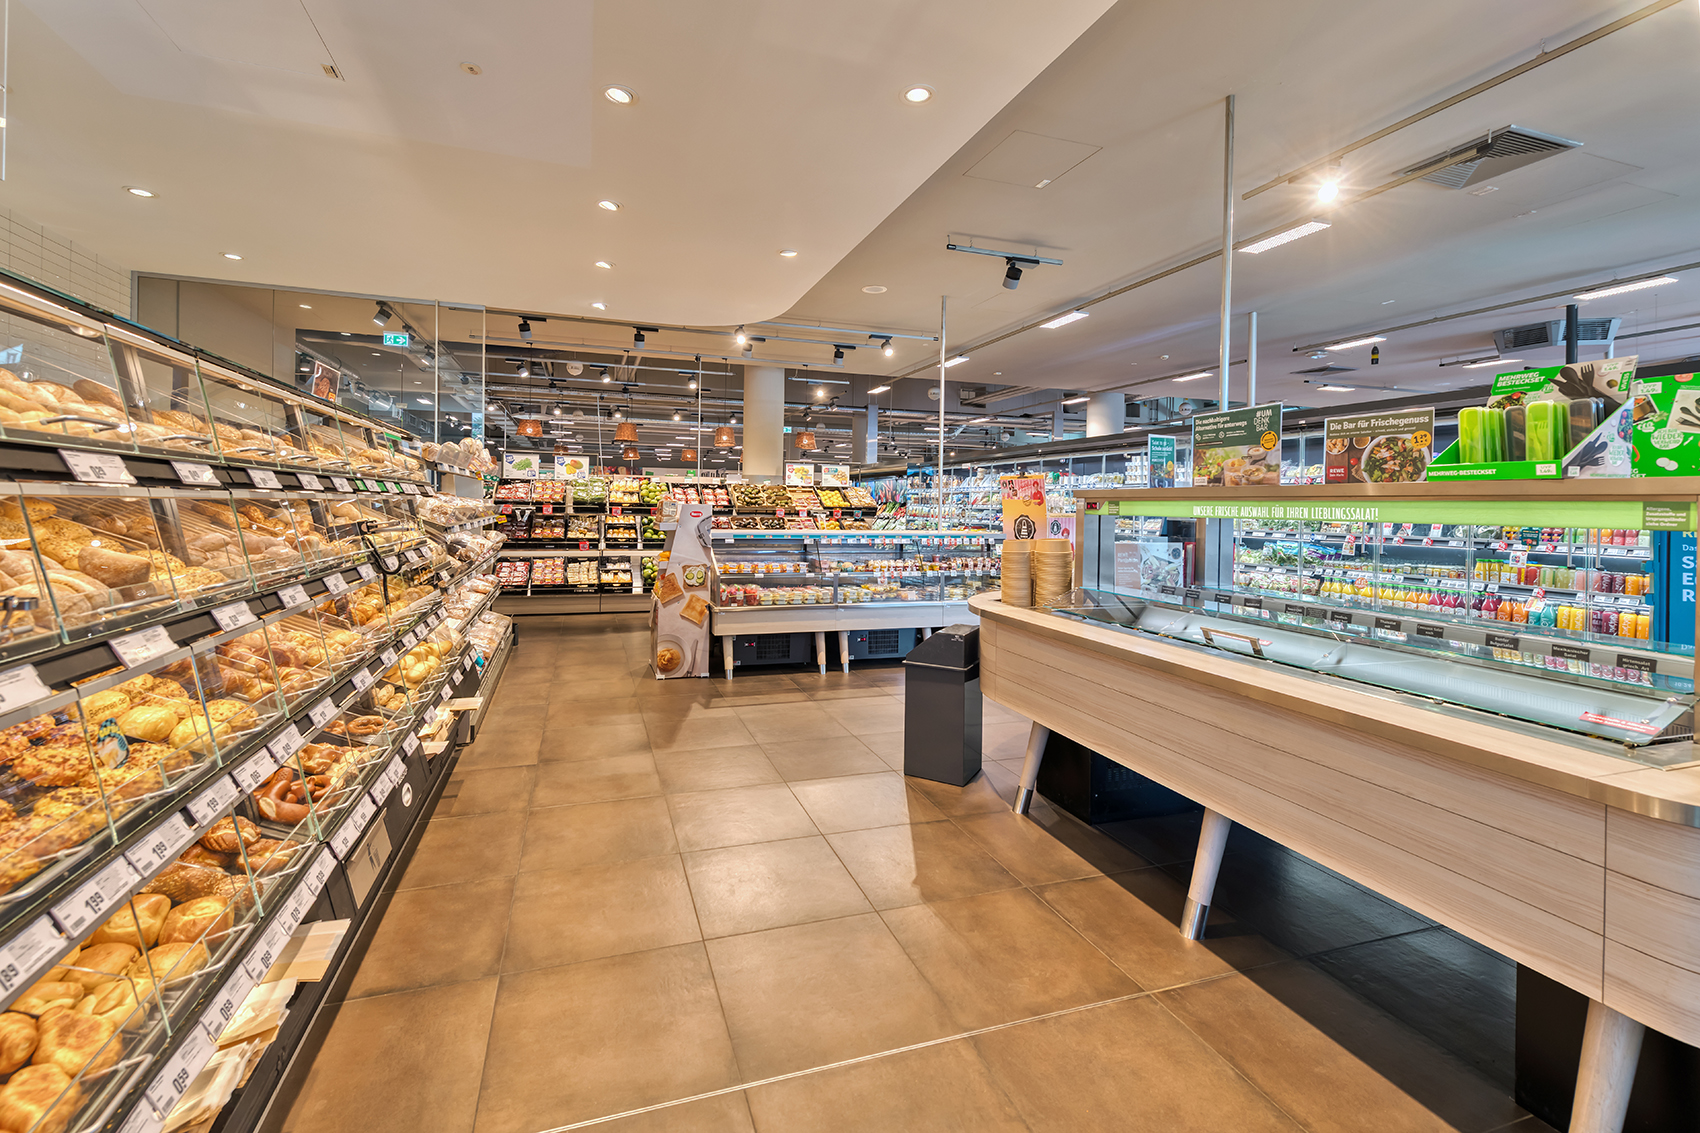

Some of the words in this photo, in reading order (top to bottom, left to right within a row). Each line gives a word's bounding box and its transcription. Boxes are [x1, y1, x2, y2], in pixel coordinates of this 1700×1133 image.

[1497, 376, 1545, 387] BESTECKSET
[1498, 372, 1539, 381] MEHRWEG
[1256, 409, 1272, 417] #UM
[1254, 417, 1270, 425] DENK
[1256, 423, 1268, 432] BAR
[1330, 422, 1342, 430] Die
[1370, 416, 1429, 427] Frischegenuss
[1193, 506, 1214, 516] UNSERE
[1215, 506, 1238, 517] FRISCHE
[1240, 506, 1269, 517] AUSWAHL
[1271, 505, 1284, 518] FÜR
[1286, 507, 1308, 519] IHREN
[1311, 507, 1378, 520] LIEBLINGSSALAT!
[1682, 556, 1697, 569] S
[1682, 573, 1696, 585] E
[1553, 646, 1588, 655] Mexikanischer
[1622, 658, 1650, 666] Hirtensalat
[206, 797, 219, 813] 1.99
[152, 841, 167, 860] 1.99
[84, 890, 106, 914] 1.99
[261, 950, 272, 969] 0.69
[0, 963, 19, 992] 1.89
[220, 999, 234, 1020] 0.69
[173, 1068, 189, 1094] 0.59
